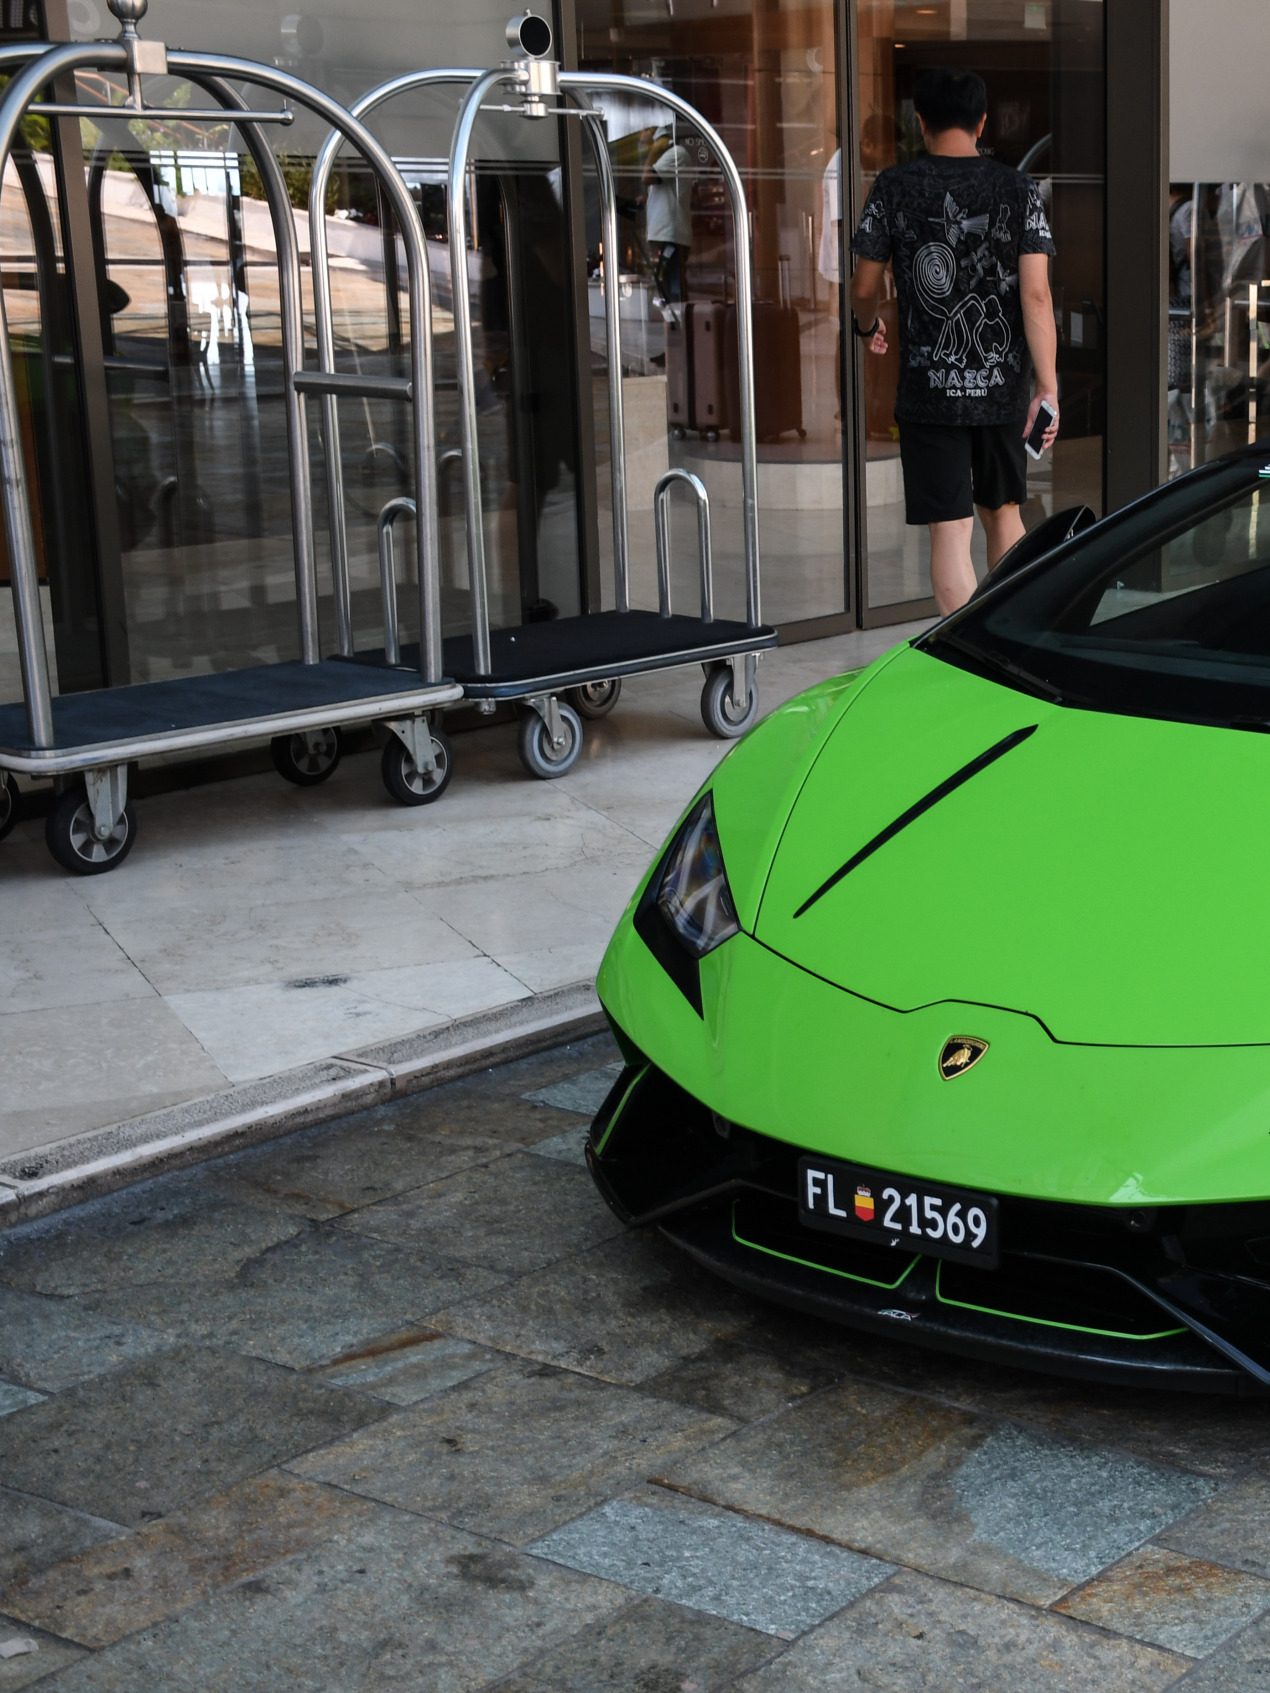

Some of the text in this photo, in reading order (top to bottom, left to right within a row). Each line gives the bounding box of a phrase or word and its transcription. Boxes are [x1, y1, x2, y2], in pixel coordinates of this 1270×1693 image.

[928, 367, 1005, 388] NAZCA
[806, 1168, 988, 1249] FL 21569
